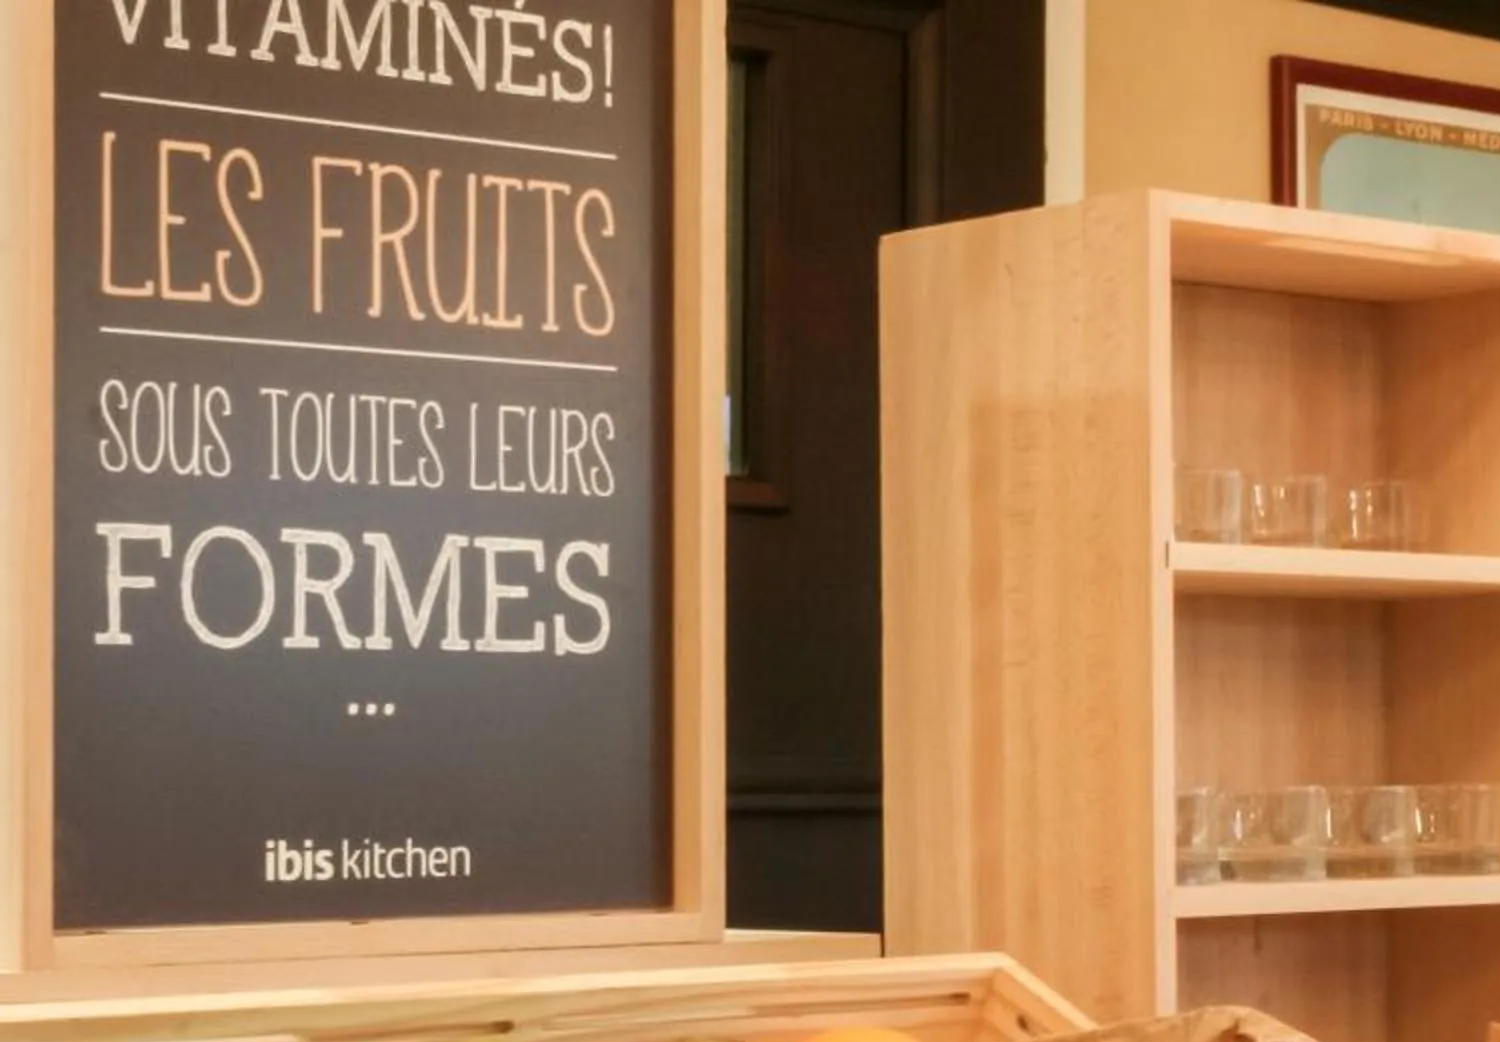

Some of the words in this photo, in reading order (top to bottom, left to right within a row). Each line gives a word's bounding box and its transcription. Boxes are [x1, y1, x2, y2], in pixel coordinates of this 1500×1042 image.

[1319, 107, 1374, 132] PARIS
[1395, 120, 1442, 143] LYON
[102, 131, 263, 307] LES
[311, 155, 616, 337] FRUITS
[99, 379, 232, 478] SOUS
[260, 387, 445, 489] TOUTES
[469, 402, 616, 497] LEURS
[94, 522, 611, 656] FORMES
[265, 839, 335, 882] ibis
[342, 838, 471, 880] kitchen
